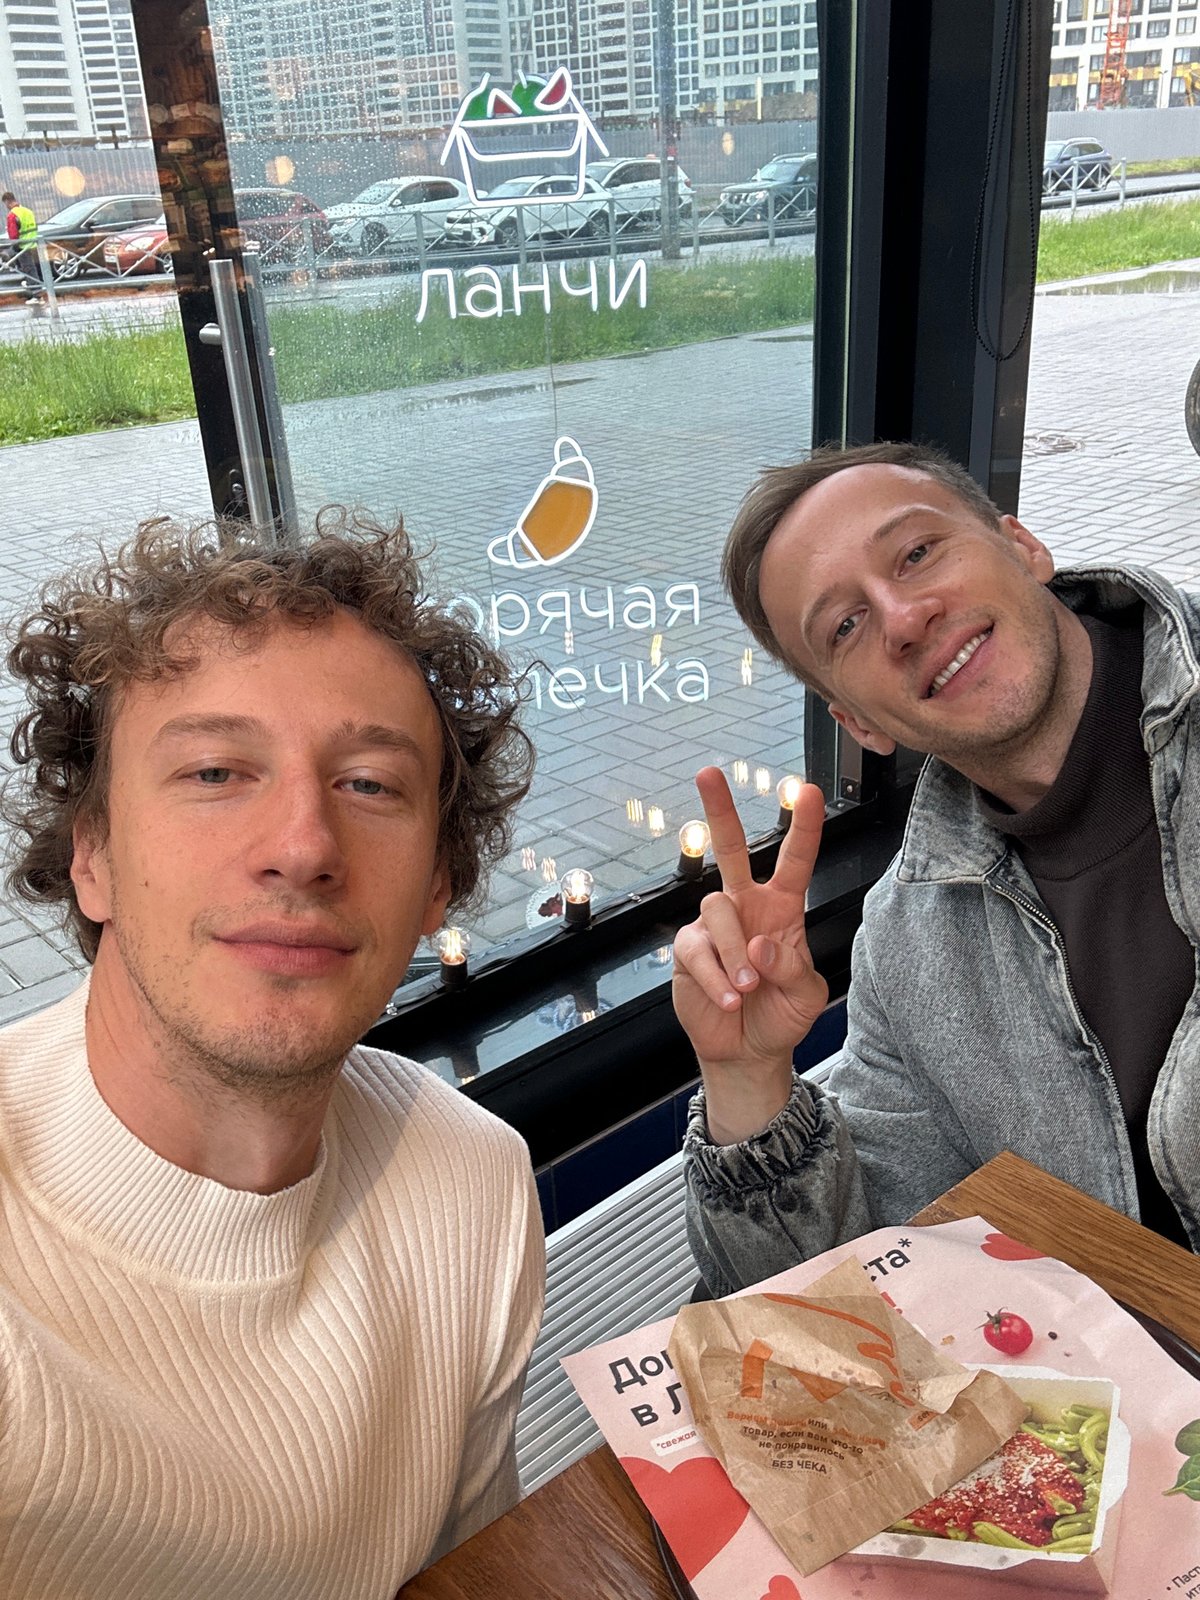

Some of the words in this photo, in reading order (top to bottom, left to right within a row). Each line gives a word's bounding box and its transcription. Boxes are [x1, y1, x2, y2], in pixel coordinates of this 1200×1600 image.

[415, 258, 648, 323] ланчи
[413, 581, 701, 650] орячая
[630, 1403, 659, 1428] в
[807, 1418, 828, 1431] или
[743, 1425, 777, 1439] товар,
[780, 1430, 804, 1438] если
[807, 1432, 828, 1443] вам
[831, 1438, 864, 1455] что-то
[758, 1441, 772, 1449] не
[775, 1442, 845, 1461] понравилось
[772, 1459, 793, 1469] БЕЗ
[797, 1460, 827, 1474] ЧЕКА
